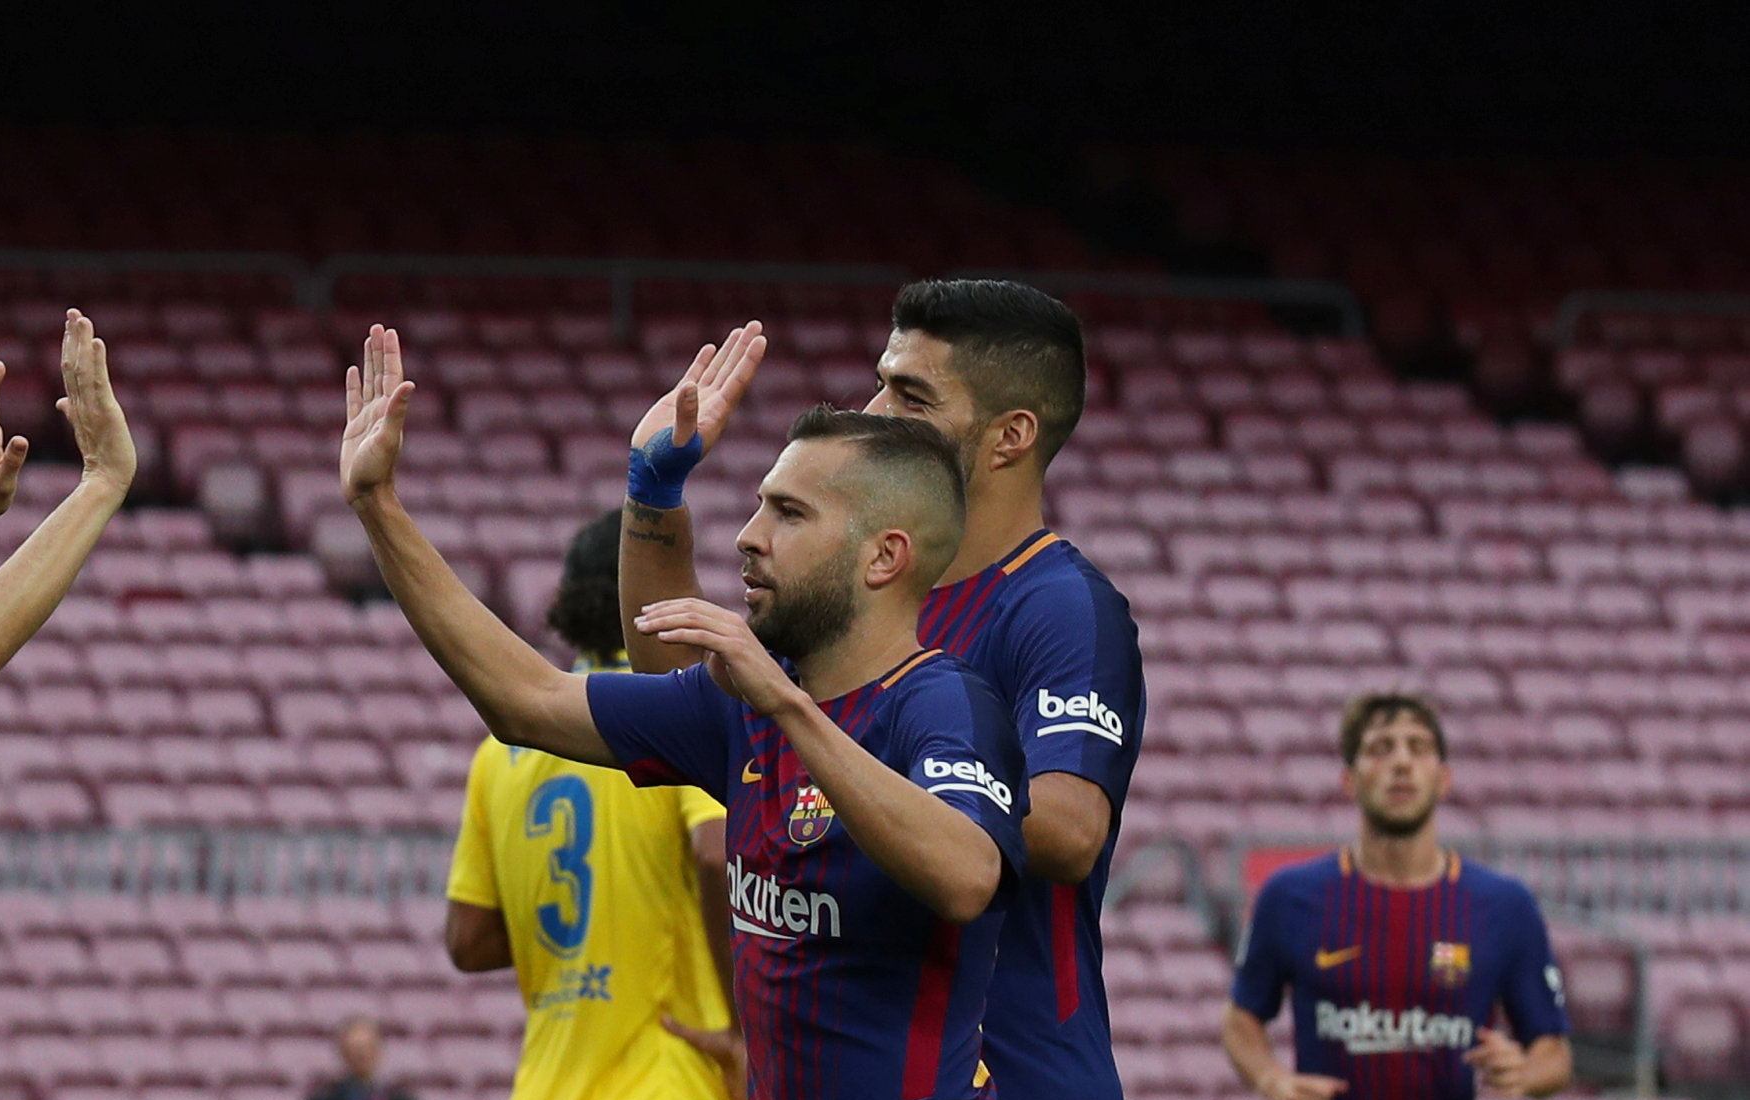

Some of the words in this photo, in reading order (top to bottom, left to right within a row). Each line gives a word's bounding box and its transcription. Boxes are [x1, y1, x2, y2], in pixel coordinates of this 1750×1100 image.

[1038, 689, 1123, 737] beko
[923, 757, 1013, 806] beko
[526, 774, 594, 960] 3
[727, 854, 841, 937] akuten
[1315, 1000, 1473, 1047] Rakuten
